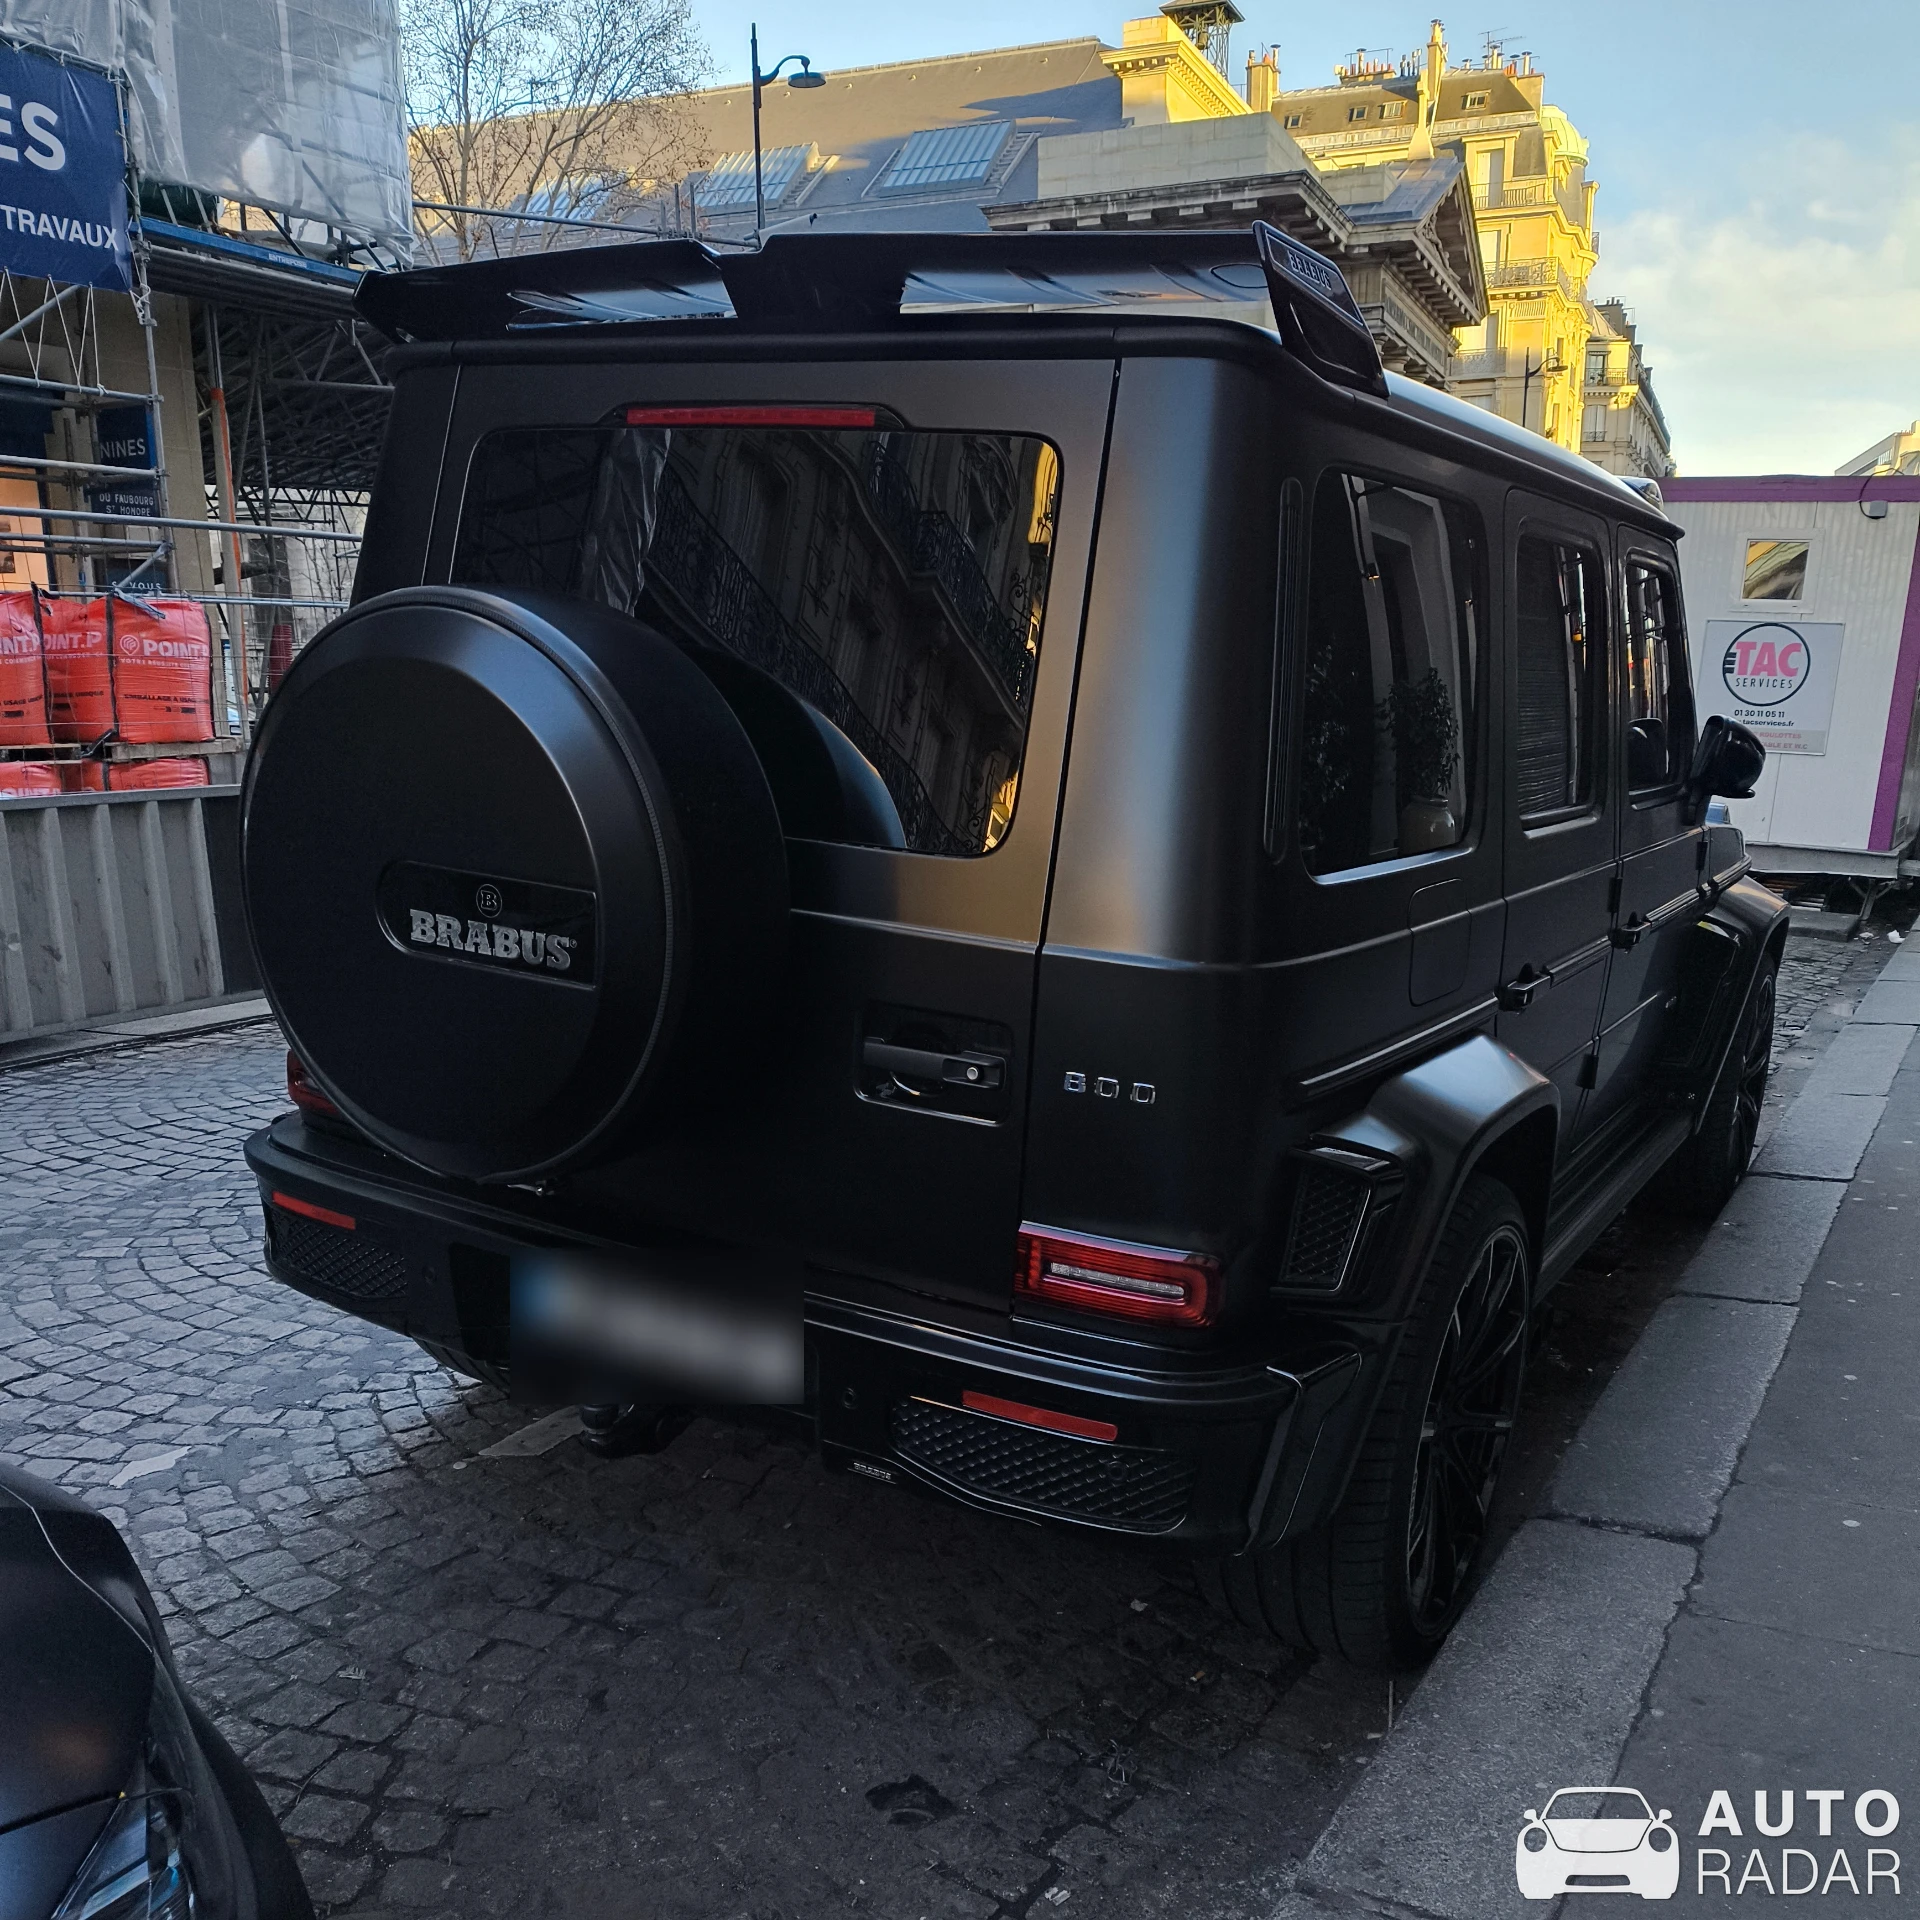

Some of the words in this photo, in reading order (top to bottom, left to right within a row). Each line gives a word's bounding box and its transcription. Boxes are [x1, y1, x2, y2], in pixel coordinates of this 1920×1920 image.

[0, 204, 119, 251] TRAVAUX
[114, 494, 154, 506] FAUBOURG
[1735, 678, 1793, 688] SERVICES
[410, 909, 571, 970] BRABUS
[1064, 1071, 1156, 1104] 800
